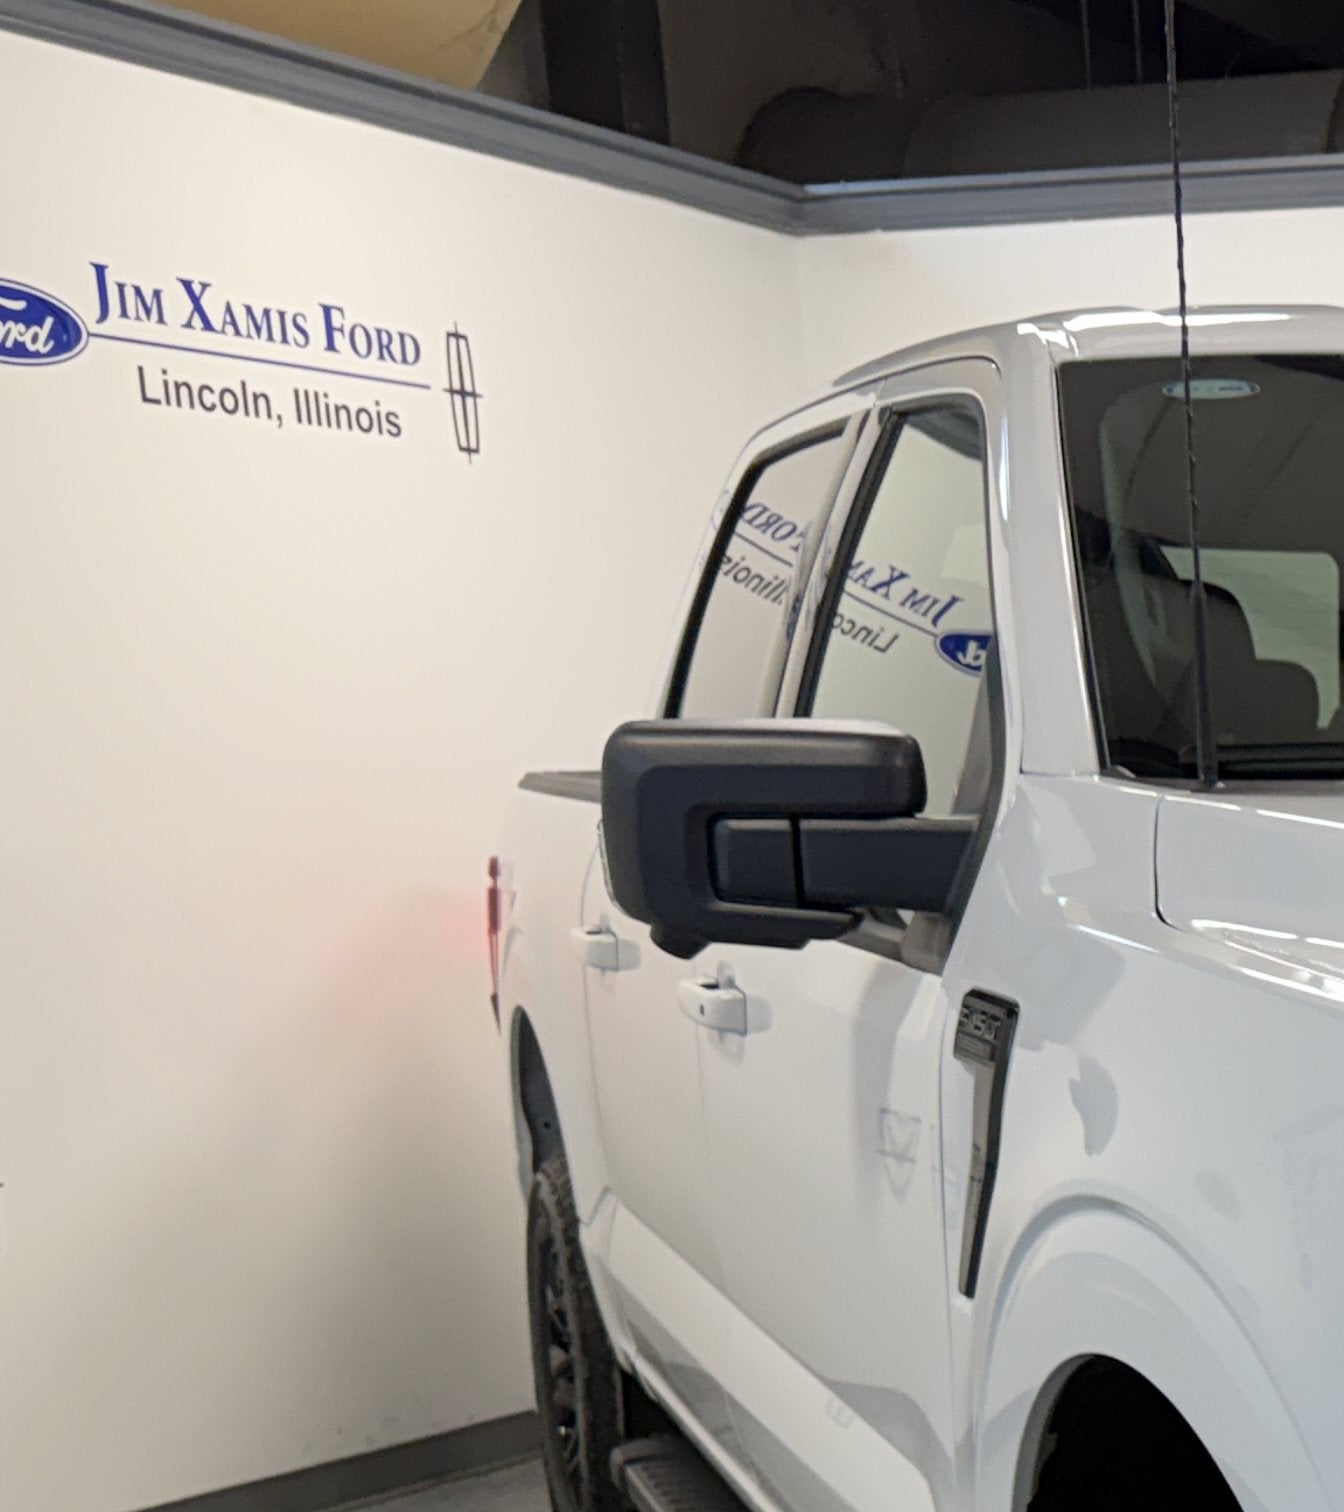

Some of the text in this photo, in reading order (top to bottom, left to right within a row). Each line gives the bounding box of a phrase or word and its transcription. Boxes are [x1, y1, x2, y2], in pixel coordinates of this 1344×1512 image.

[0, 296, 55, 354] rd
[89, 261, 422, 366] JIM XAMIS FORD
[137, 365, 402, 438] Lincoln, Illinois
